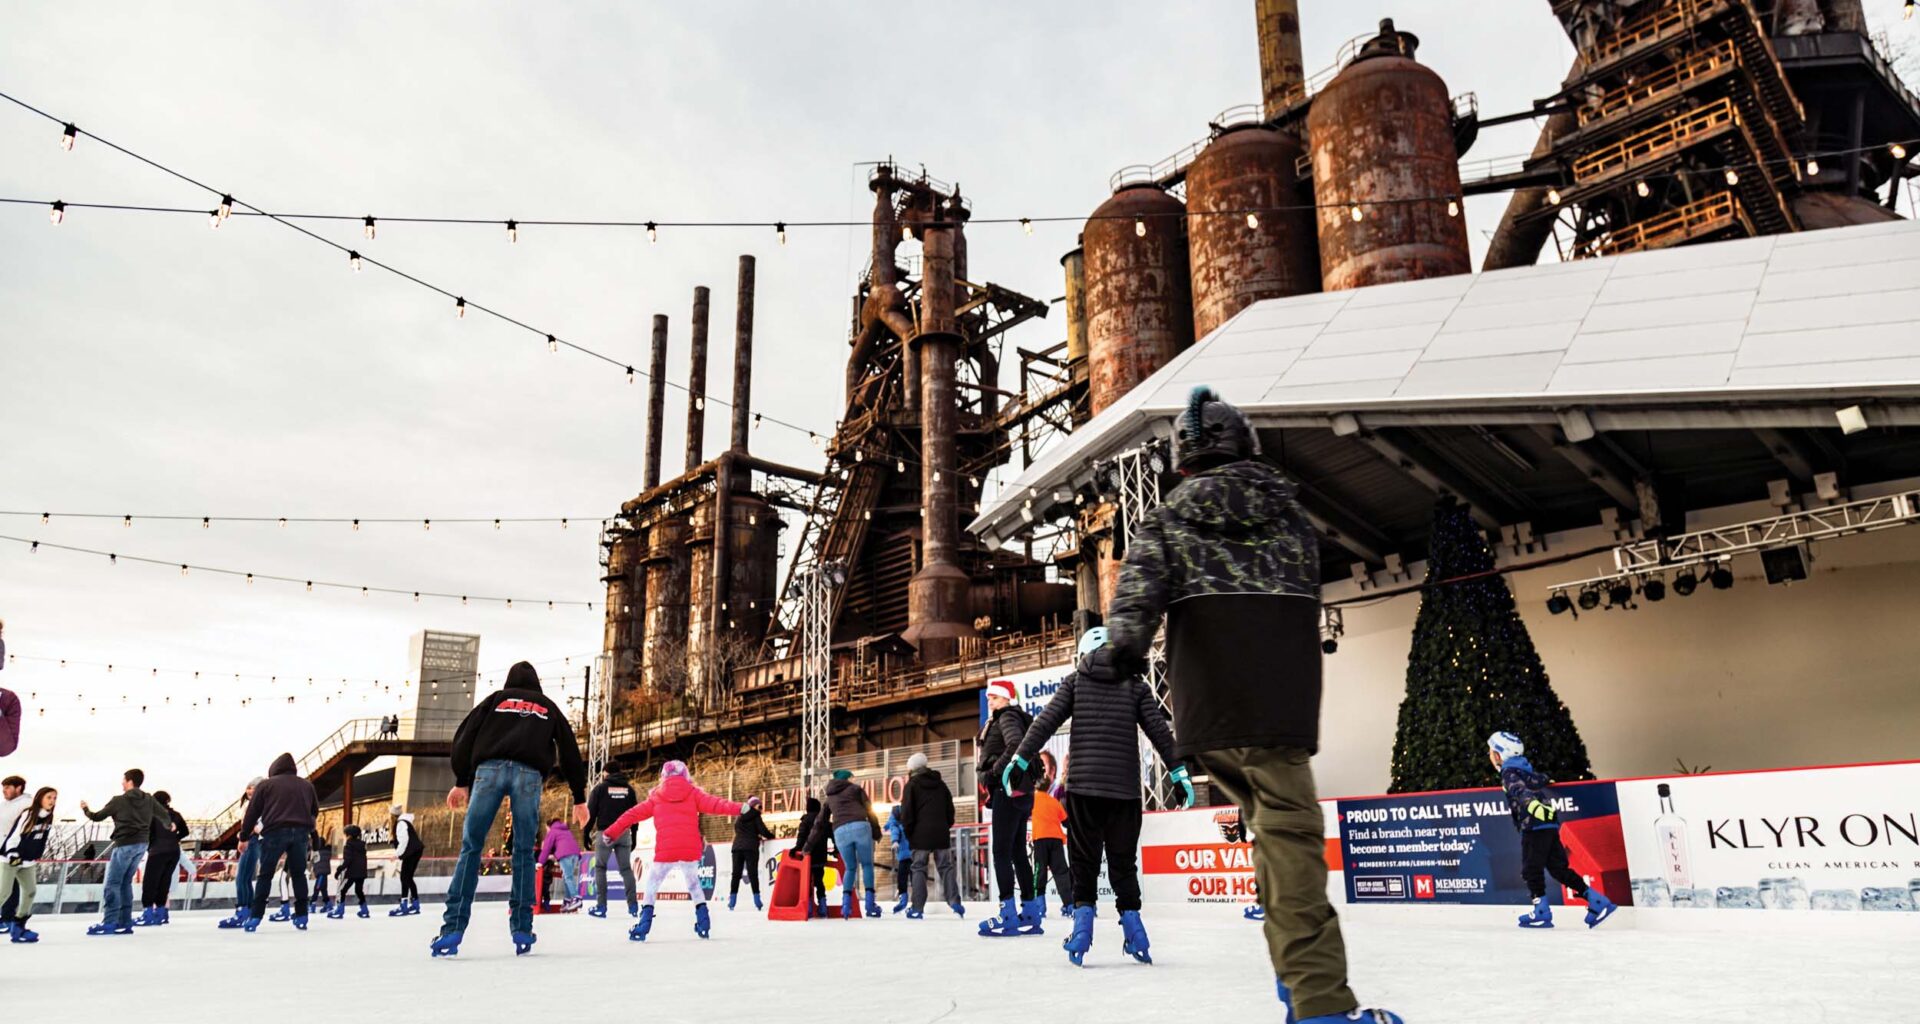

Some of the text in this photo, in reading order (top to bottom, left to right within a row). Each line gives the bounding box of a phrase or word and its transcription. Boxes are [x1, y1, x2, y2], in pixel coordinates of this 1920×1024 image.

[1346, 808, 1388, 823] PROUD
[1390, 807, 1407, 821] TO
[1409, 805, 1443, 820] CALL
[1444, 803, 1472, 818] THE
[1550, 797, 1579, 812] ME.
[1348, 823, 1480, 840] Find a branch near you and
[1706, 816, 1826, 849] KLYR
[1349, 843, 1386, 854] become
[1388, 845, 1395, 853] a
[1396, 841, 1440, 853] member
[1175, 848, 1216, 869] OUR
[1768, 861, 1900, 869] CLEAN AMERICAN
[1188, 876, 1227, 895] OUR
[1435, 879, 1478, 889] MEMBERS
